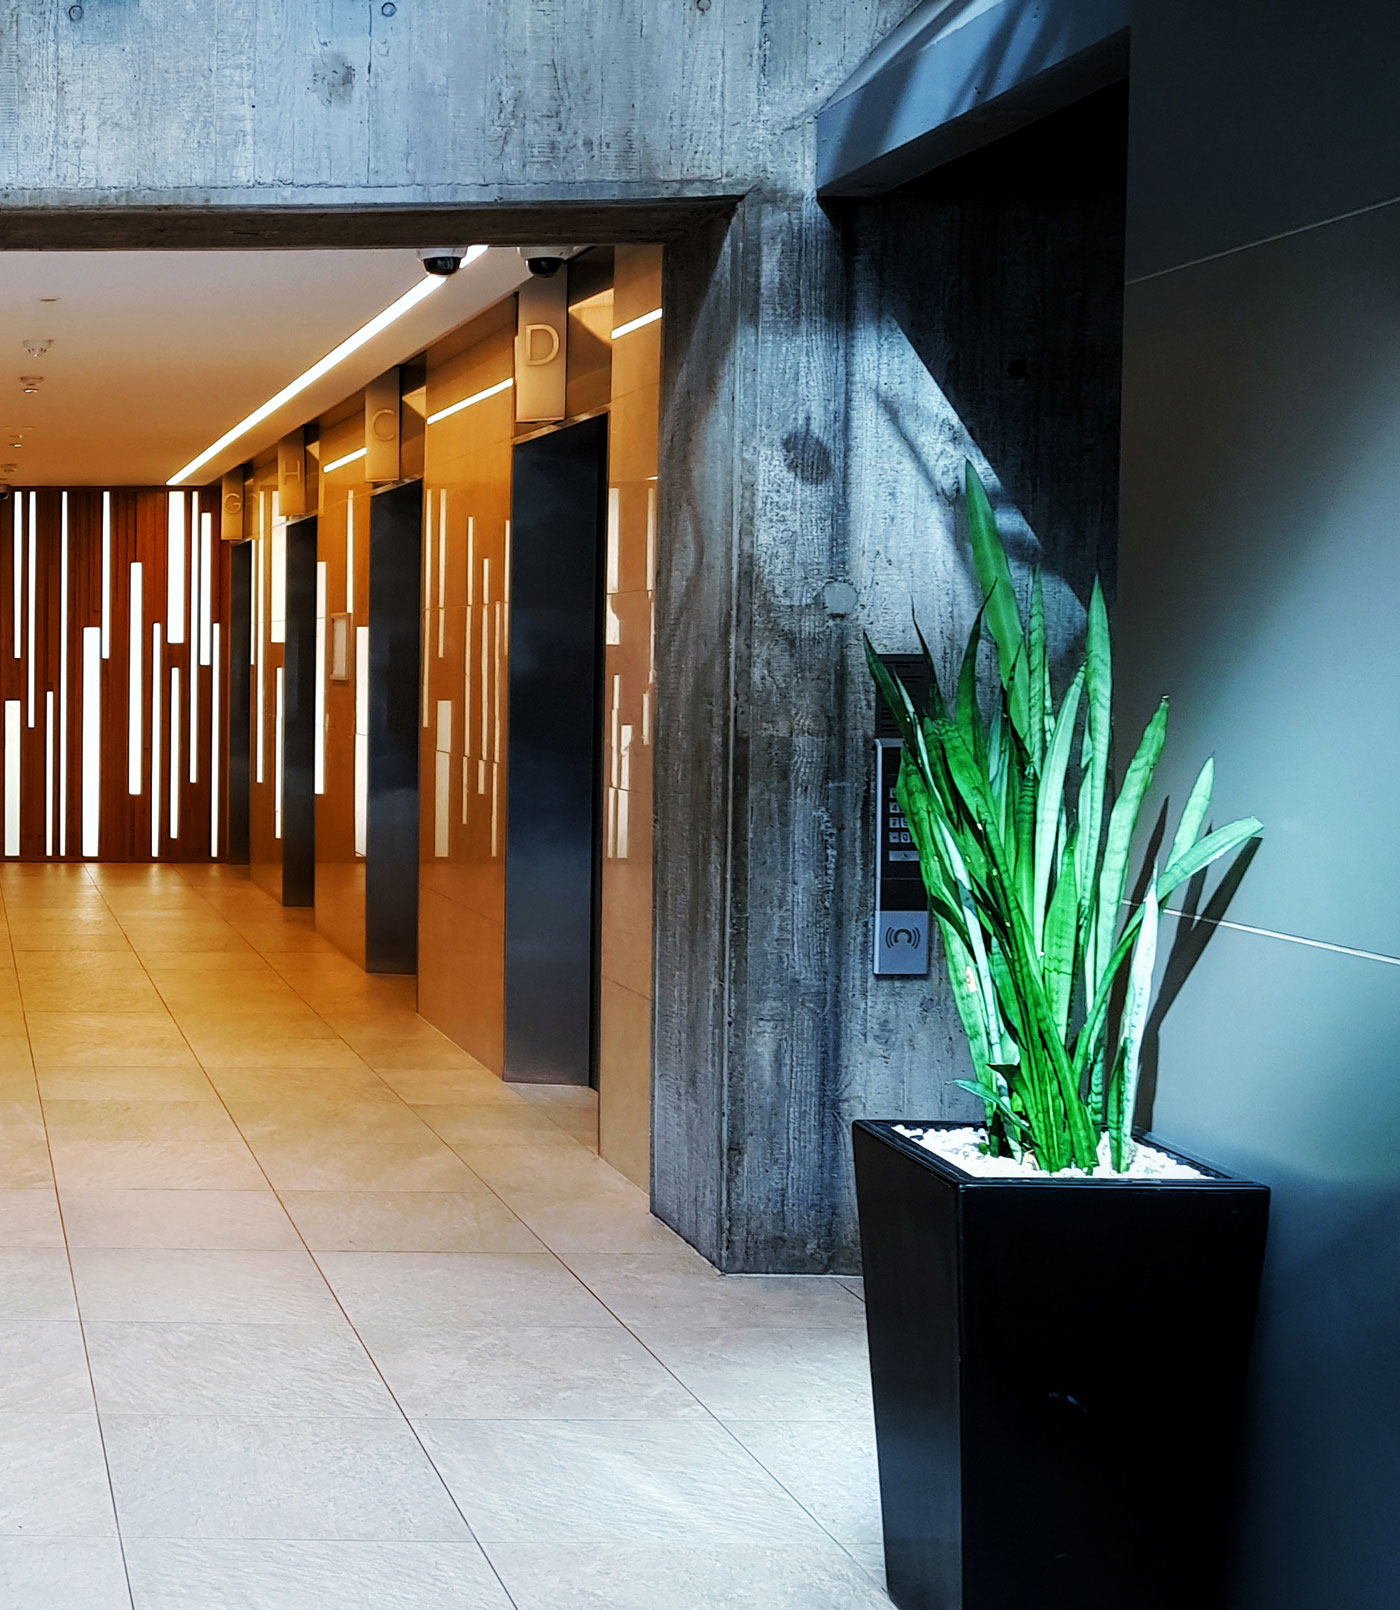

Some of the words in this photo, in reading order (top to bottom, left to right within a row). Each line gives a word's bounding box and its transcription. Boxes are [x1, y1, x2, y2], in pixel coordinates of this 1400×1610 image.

[525, 324, 560, 366] D
[372, 409, 395, 441] C
[283, 460, 300, 484] H
[224, 492, 241, 514] G
